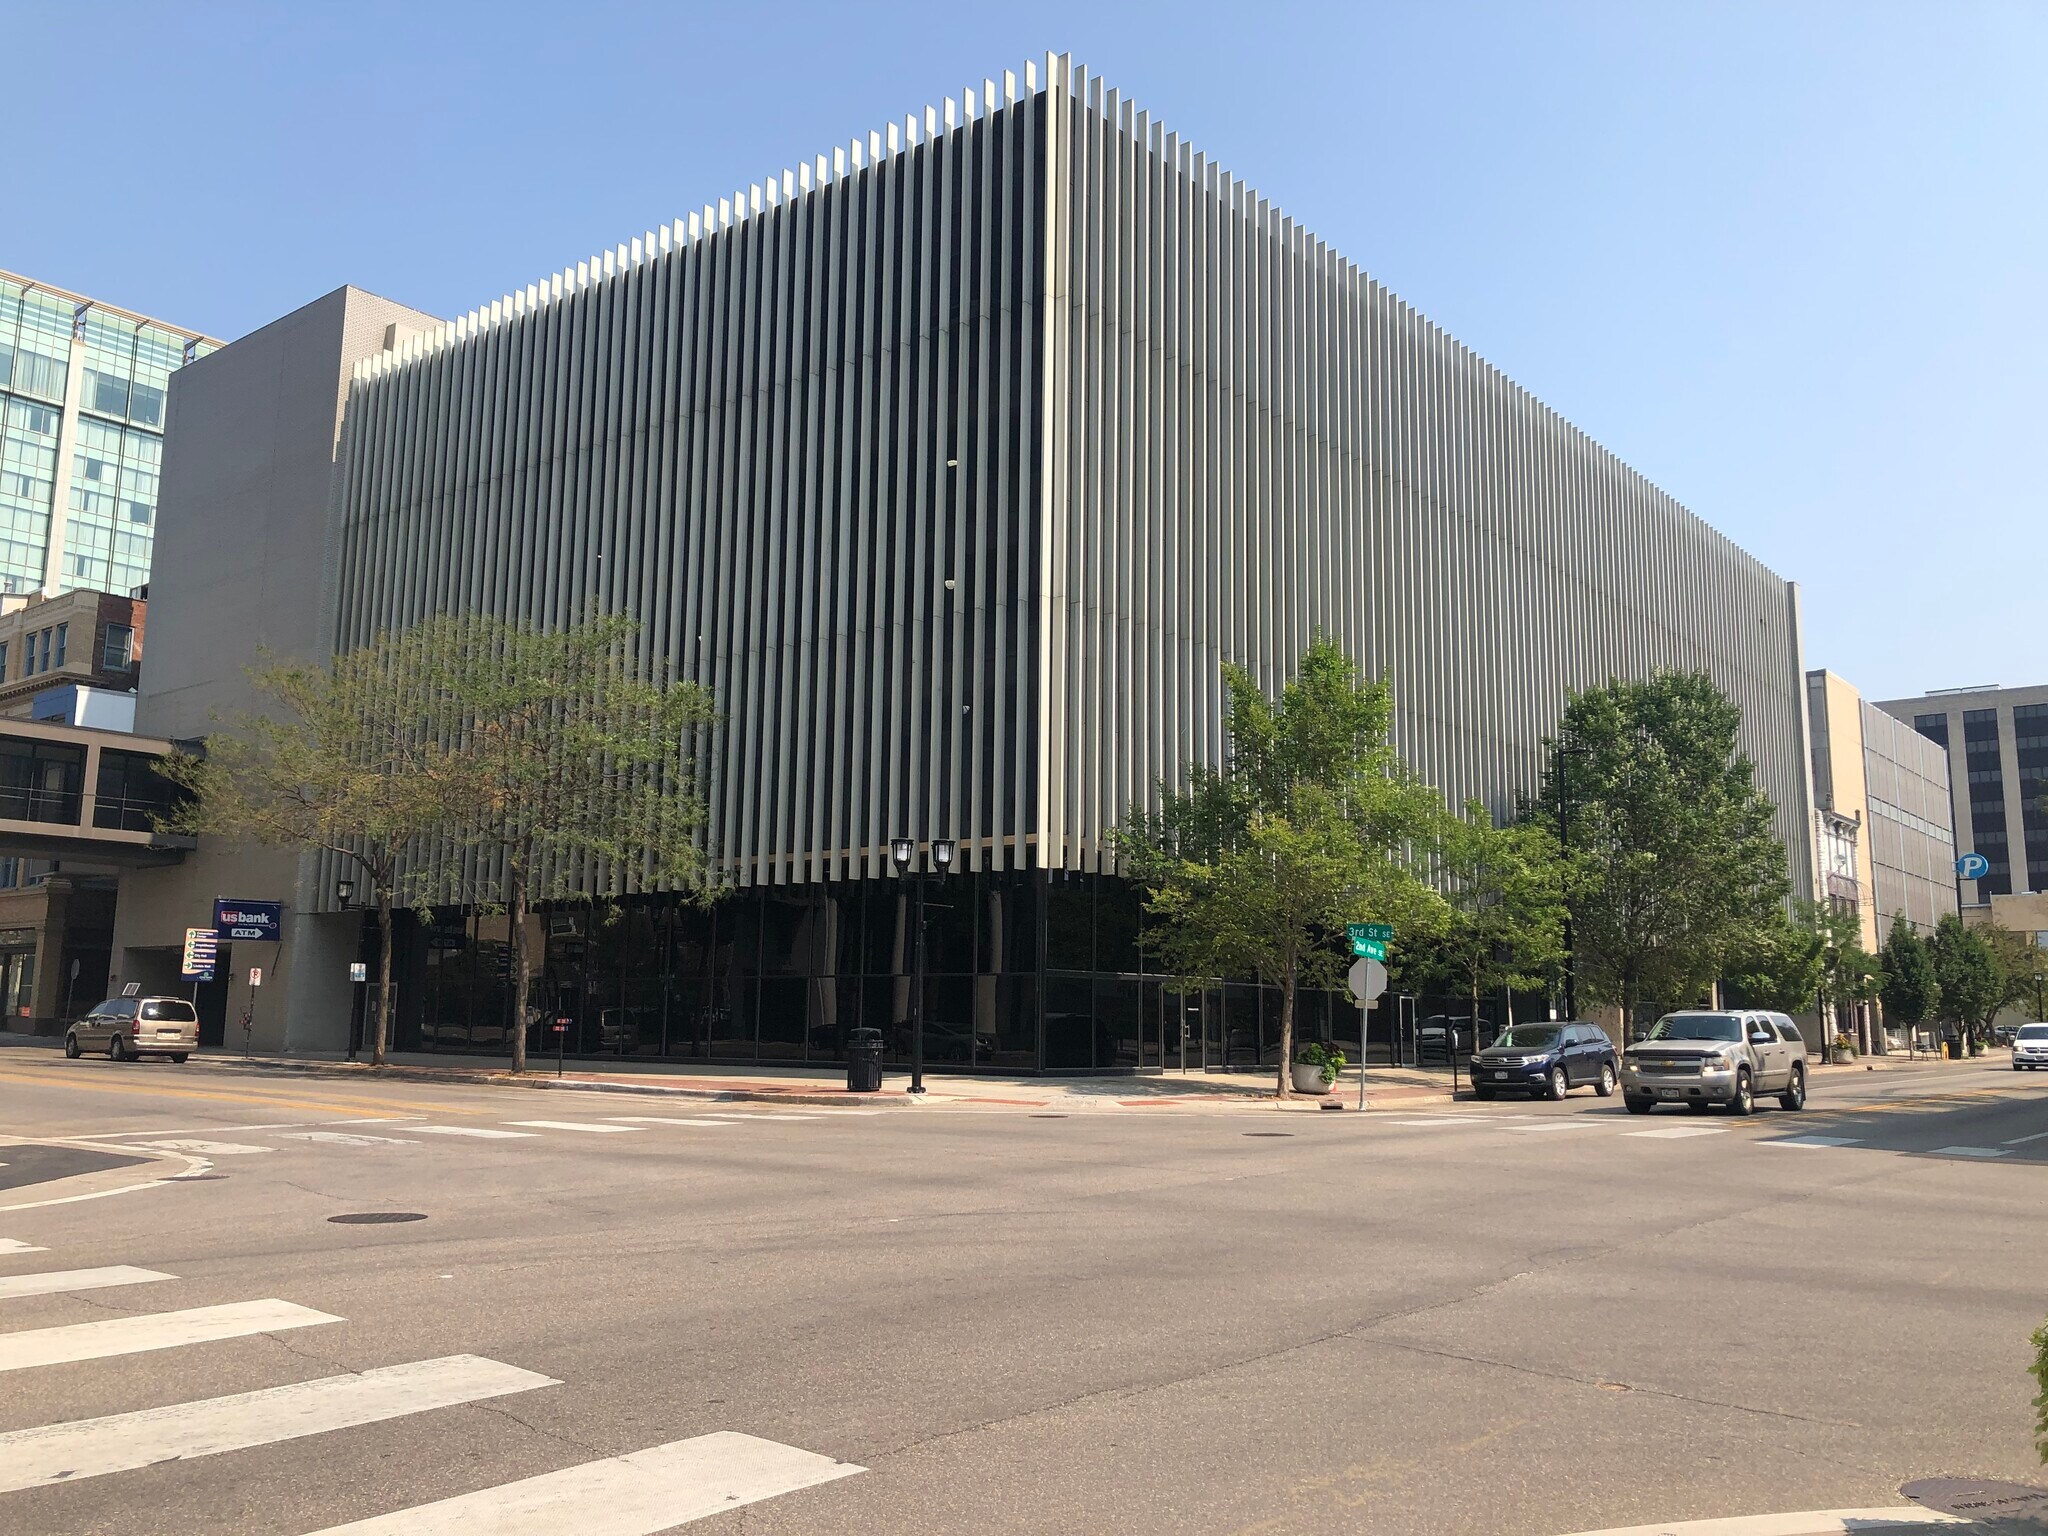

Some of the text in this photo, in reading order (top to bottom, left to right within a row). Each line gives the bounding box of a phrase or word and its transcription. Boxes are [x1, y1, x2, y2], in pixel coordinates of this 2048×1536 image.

[1964, 857, 1982, 876] P
[1349, 927, 1364, 937] 3rd
[1368, 928, 1378, 937] St
[1355, 941, 1366, 952] 2nd
[1366, 944, 1377, 955] Ave
